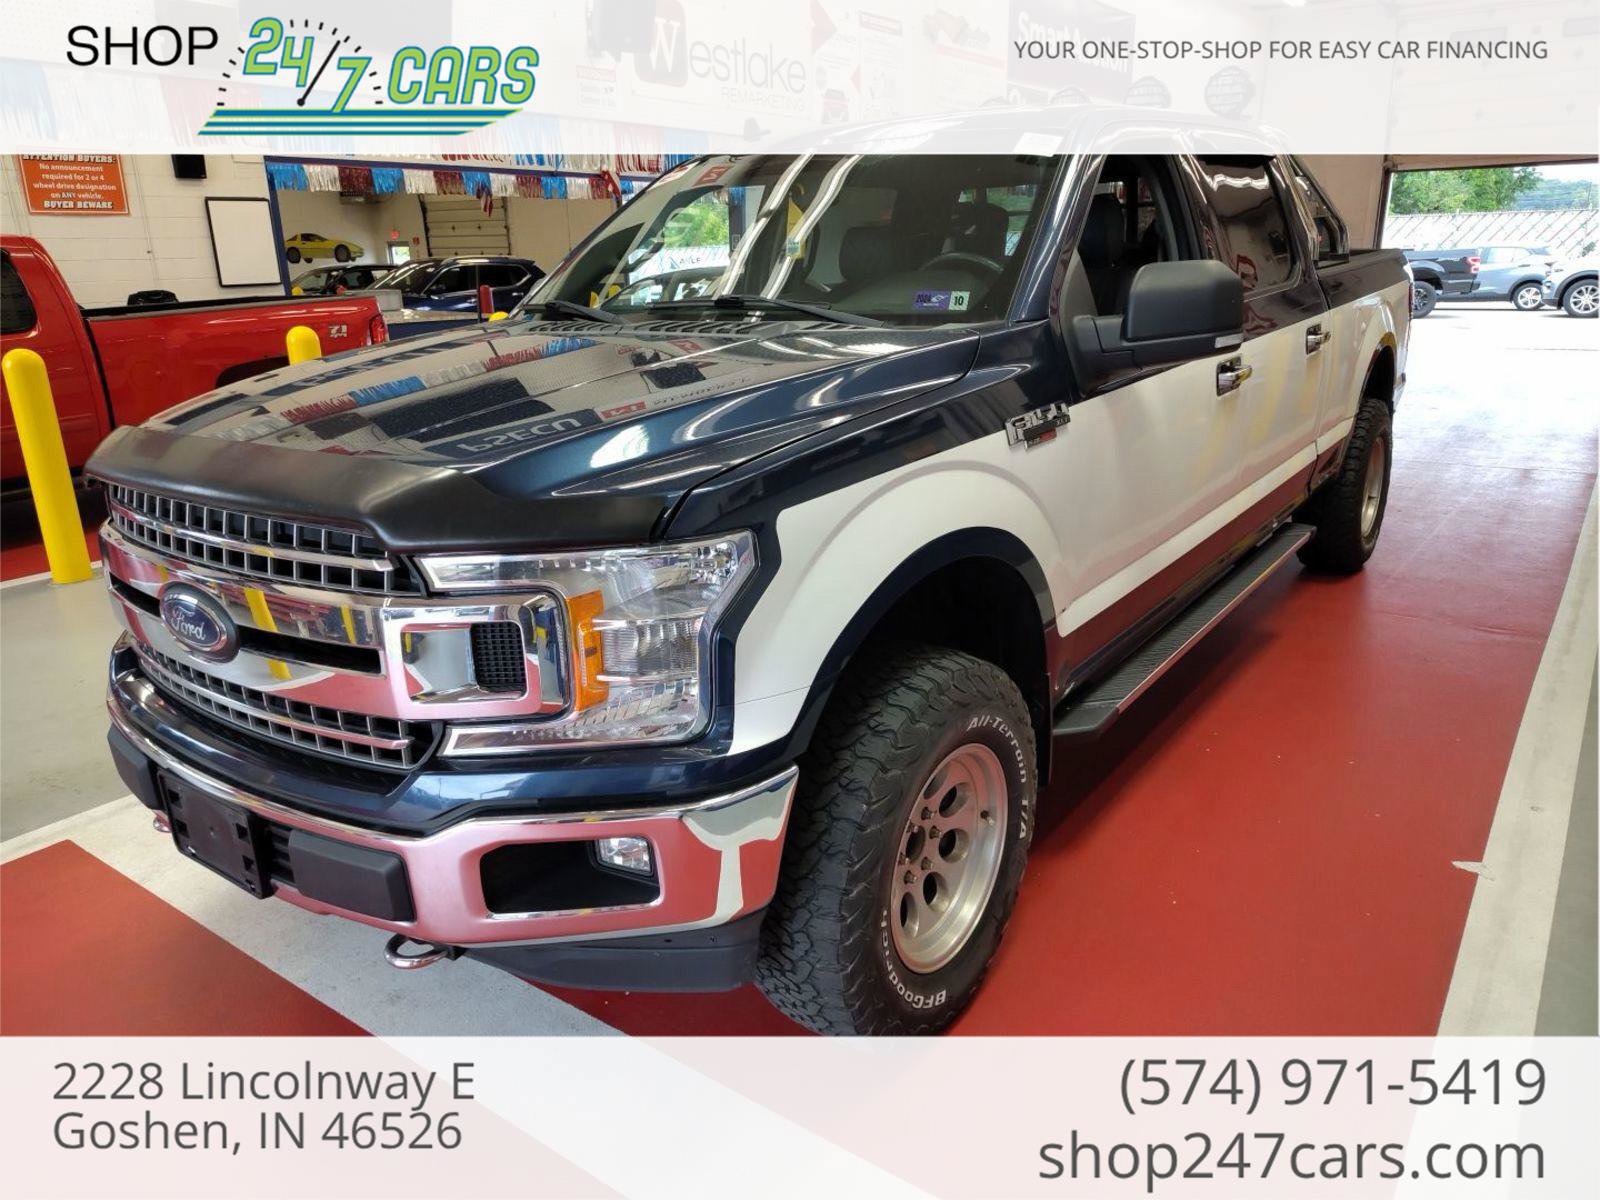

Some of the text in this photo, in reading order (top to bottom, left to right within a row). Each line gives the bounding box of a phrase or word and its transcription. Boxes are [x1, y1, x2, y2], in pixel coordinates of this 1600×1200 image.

[42, 173, 73, 181] required
[75, 183, 117, 191] designation
[43, 200, 113, 209] BUYER BEWARE
[171, 605, 207, 641] Ford
[966, 714, 1027, 783] All-Terrain
